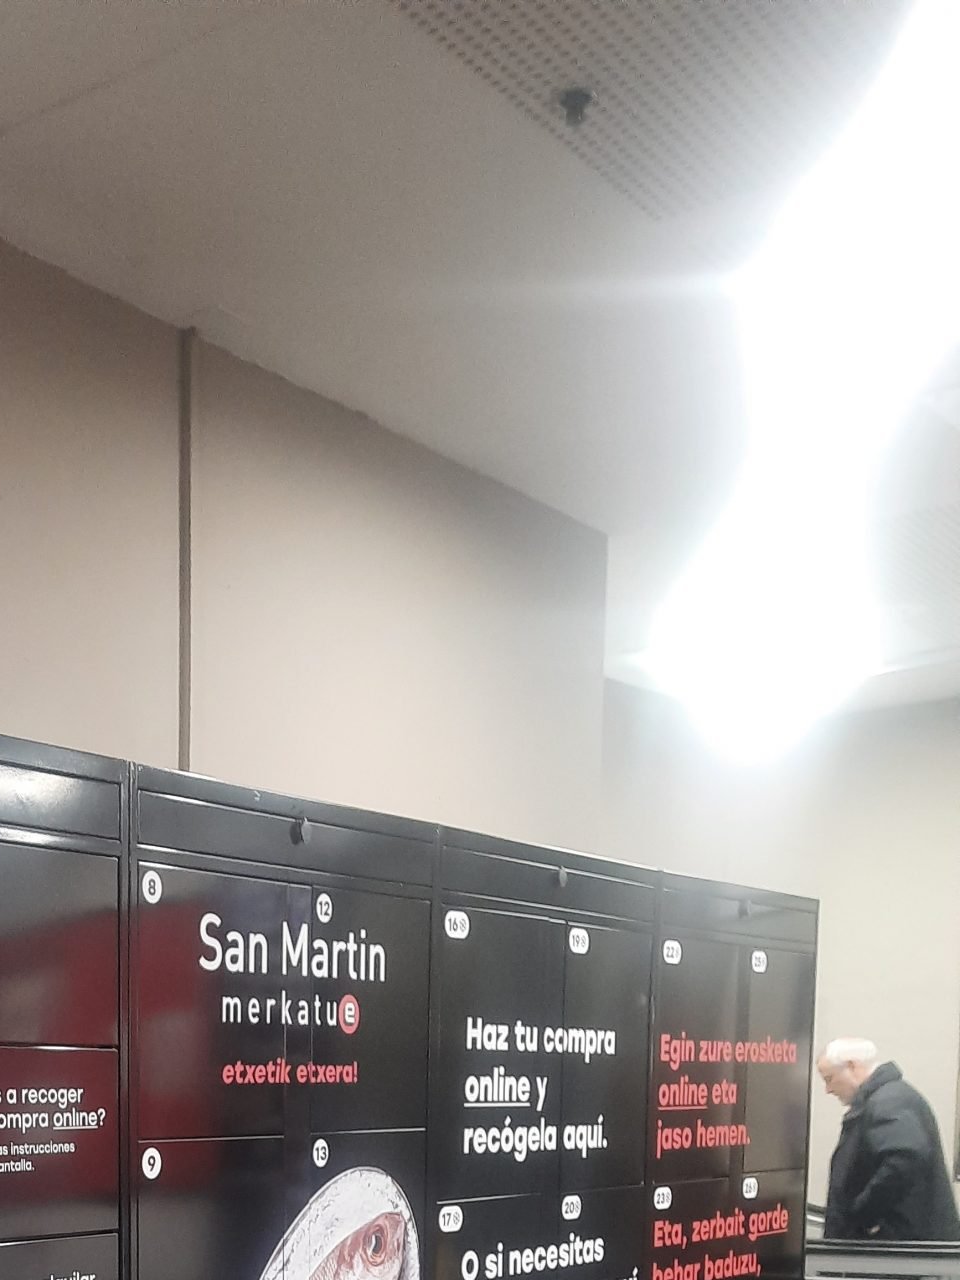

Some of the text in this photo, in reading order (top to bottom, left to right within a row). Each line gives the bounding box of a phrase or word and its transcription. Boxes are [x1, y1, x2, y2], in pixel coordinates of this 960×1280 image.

[147, 879, 156, 896] 8
[318, 901, 330, 917] 12
[198, 912, 386, 983] San Martin
[221, 990, 356, 1026] merkatue
[466, 1016, 616, 1064] Haz tu compra
[660, 1032, 797, 1071] Egin zure erosketa
[222, 1056, 358, 1085] etxetik etxera!
[6, 1090, 17, 1105] a
[21, 1088, 84, 1109] recoger
[464, 1066, 548, 1111] online y
[658, 1075, 738, 1110] online eta
[53, 1108, 106, 1130] online?
[10, 1140, 75, 1155] instrucciones
[315, 1146, 328, 1161] 13
[463, 1114, 608, 1163] recógela aquí.
[656, 1118, 750, 1160] jaso hemen.
[147, 1155, 156, 1172] 9
[653, 1203, 789, 1249] Eta, zerbait gorde
[485, 1242, 504, 1280] si
[509, 1232, 605, 1275] necesitas
